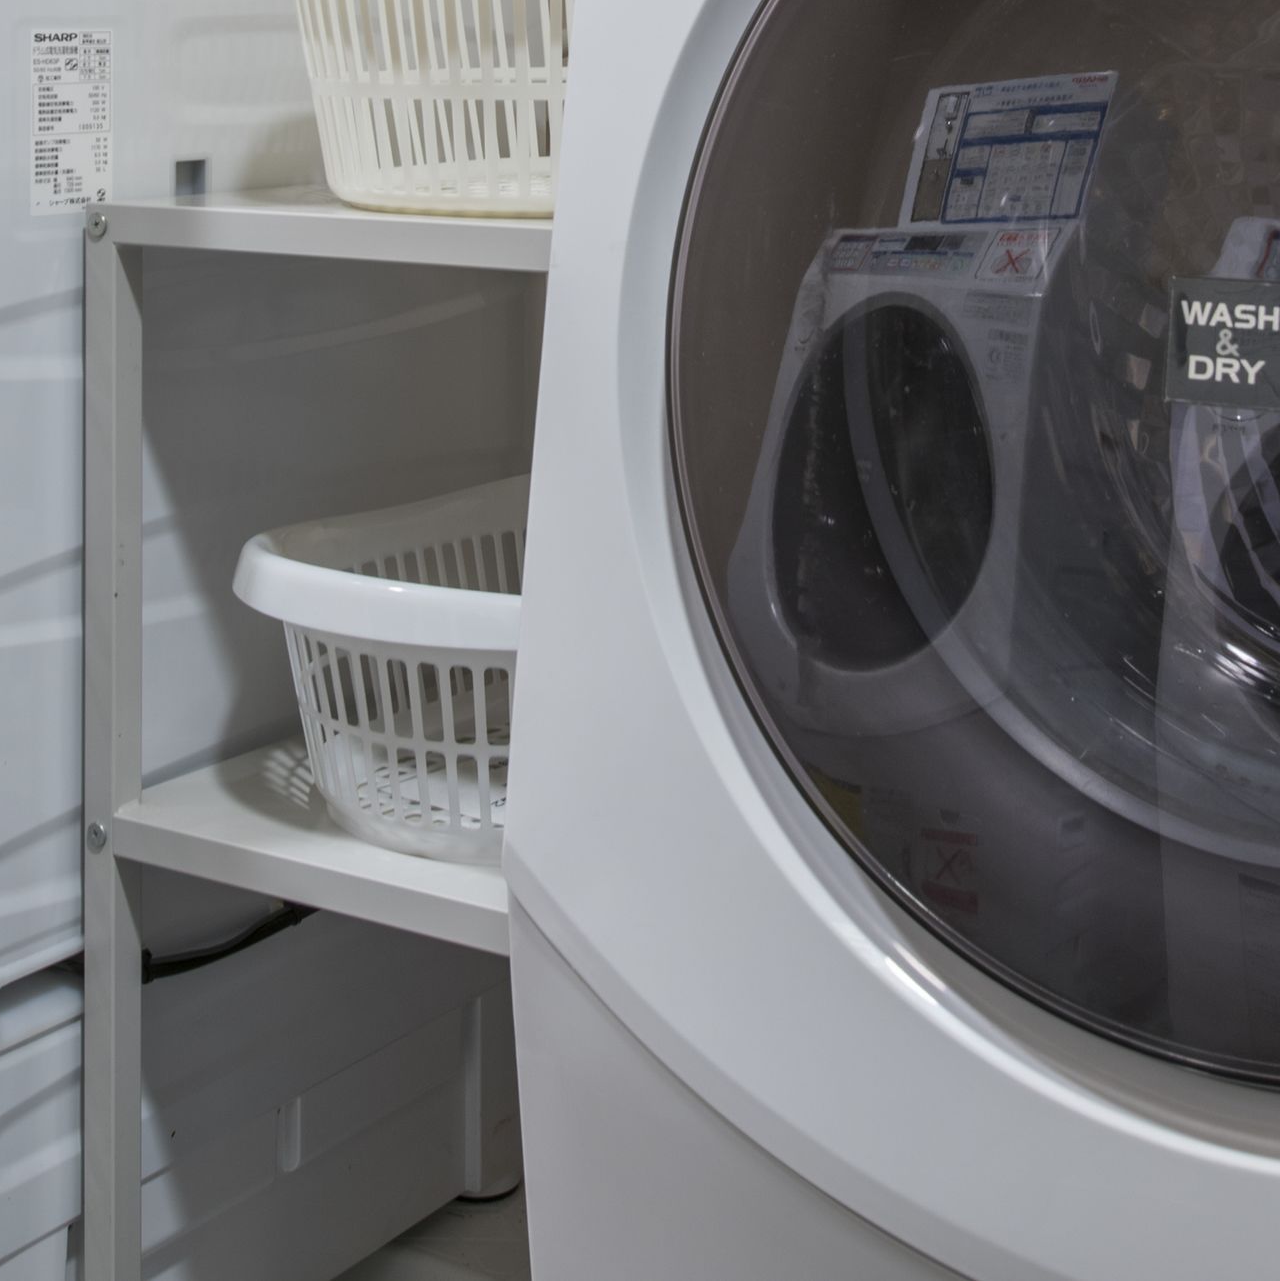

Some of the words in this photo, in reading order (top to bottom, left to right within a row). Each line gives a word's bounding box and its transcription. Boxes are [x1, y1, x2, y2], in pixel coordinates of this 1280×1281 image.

[33, 32, 78, 43] SHARP
[1181, 300, 1280, 332] WASH
[1216, 328, 1240, 357] &
[1188, 354, 1266, 385] DRY
